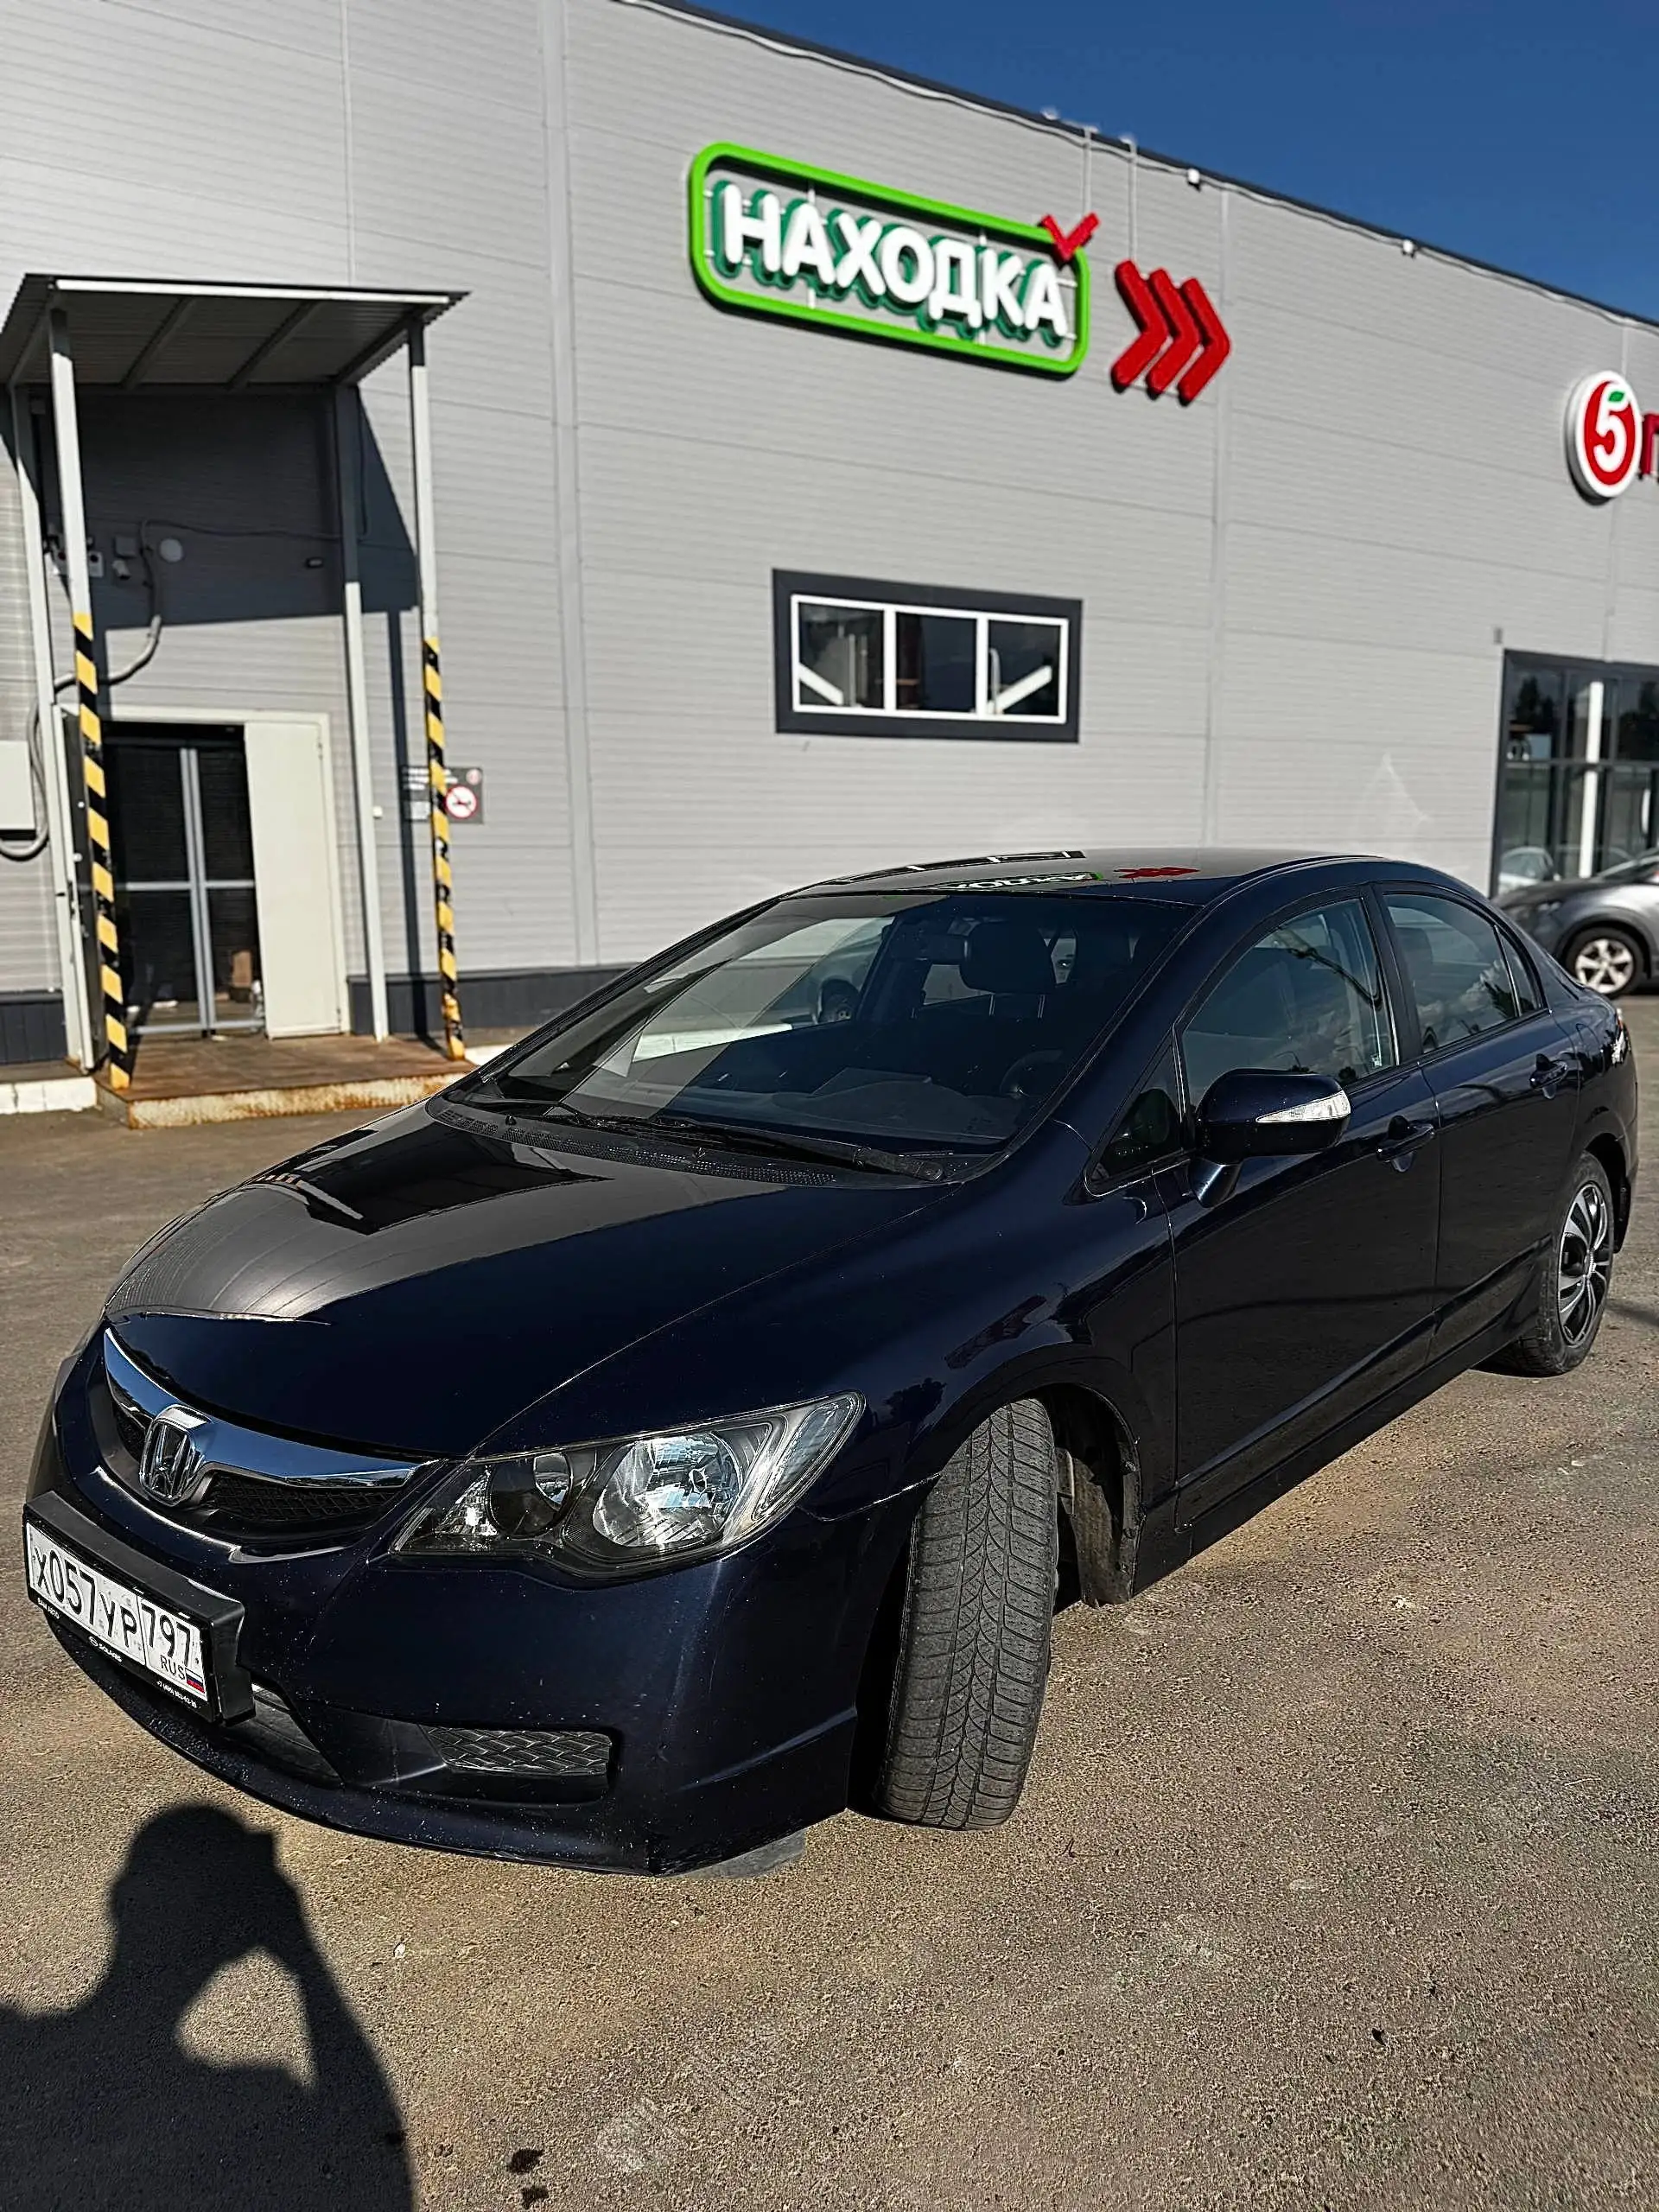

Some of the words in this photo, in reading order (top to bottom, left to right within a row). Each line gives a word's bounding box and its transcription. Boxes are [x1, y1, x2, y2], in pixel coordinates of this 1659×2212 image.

[717, 181, 1070, 340] НАХОДКА
[1592, 382, 1630, 473] 5
[142, 1602, 192, 1667] 797
[160, 1654, 186, 1681] RUS
